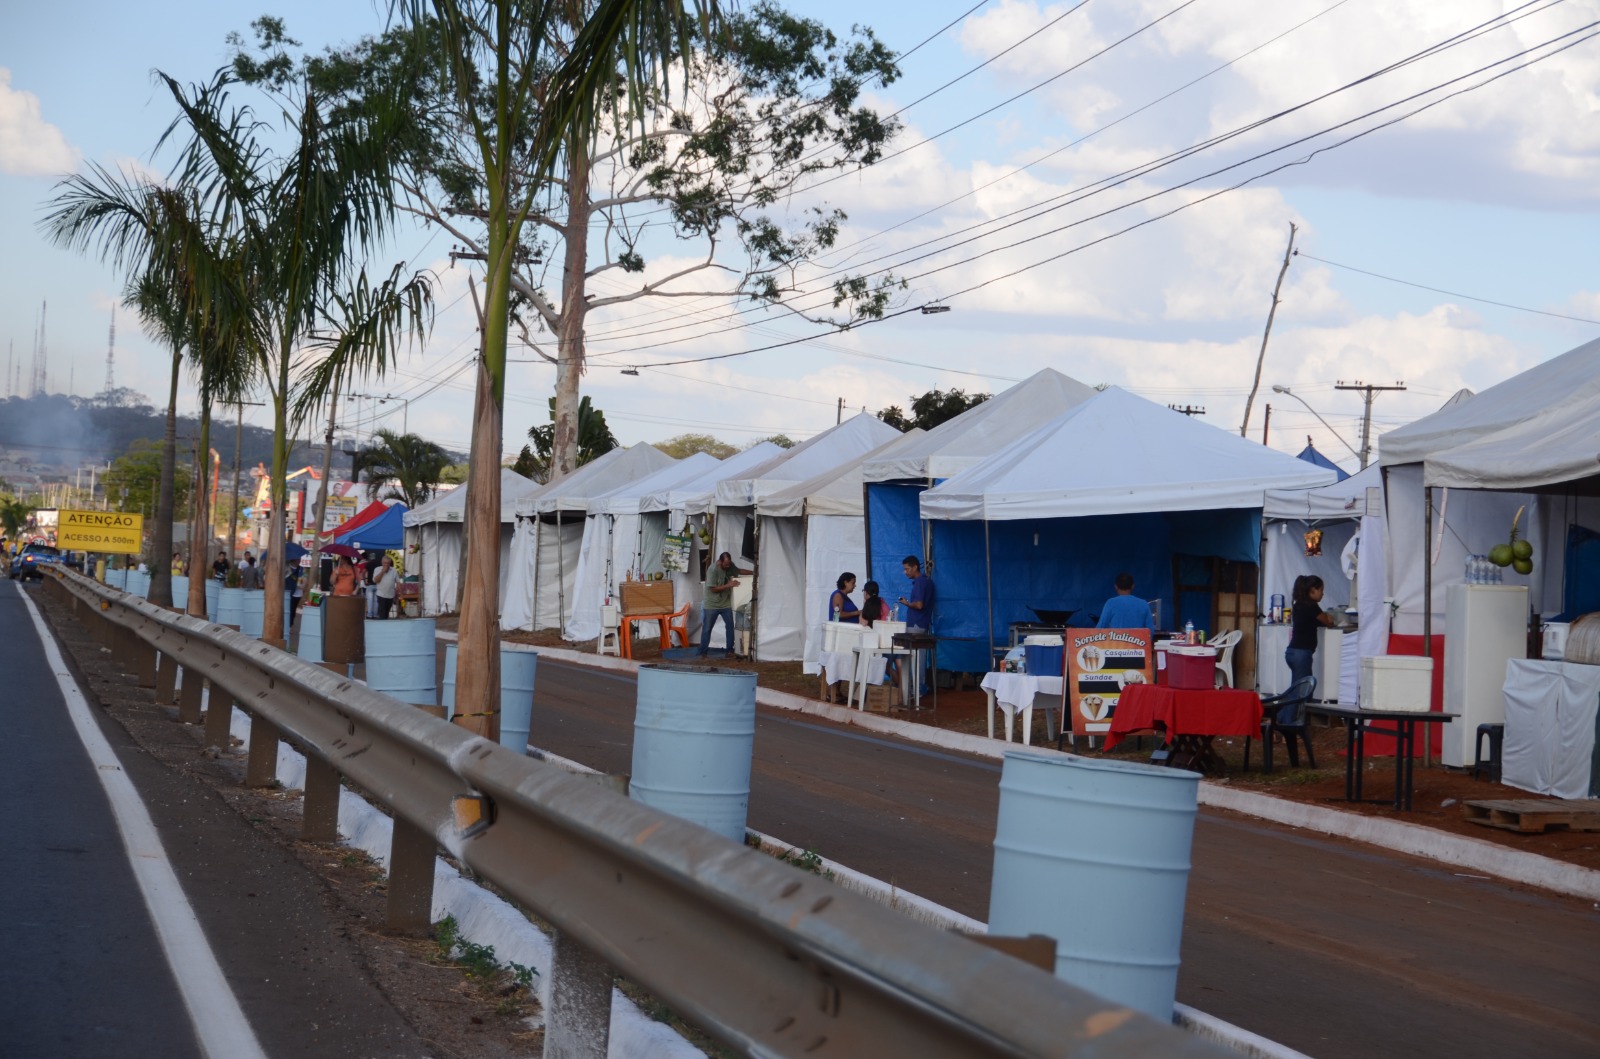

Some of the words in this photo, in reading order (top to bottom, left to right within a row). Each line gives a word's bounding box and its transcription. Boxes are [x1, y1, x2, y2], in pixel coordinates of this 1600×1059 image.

[68, 514, 133, 527] ATENÇÃO
[64, 533, 102, 543] ACESSO
[112, 536, 135, 545] 500m
[1074, 633, 1106, 648] Sorvete
[1108, 632, 1146, 646] Italiano
